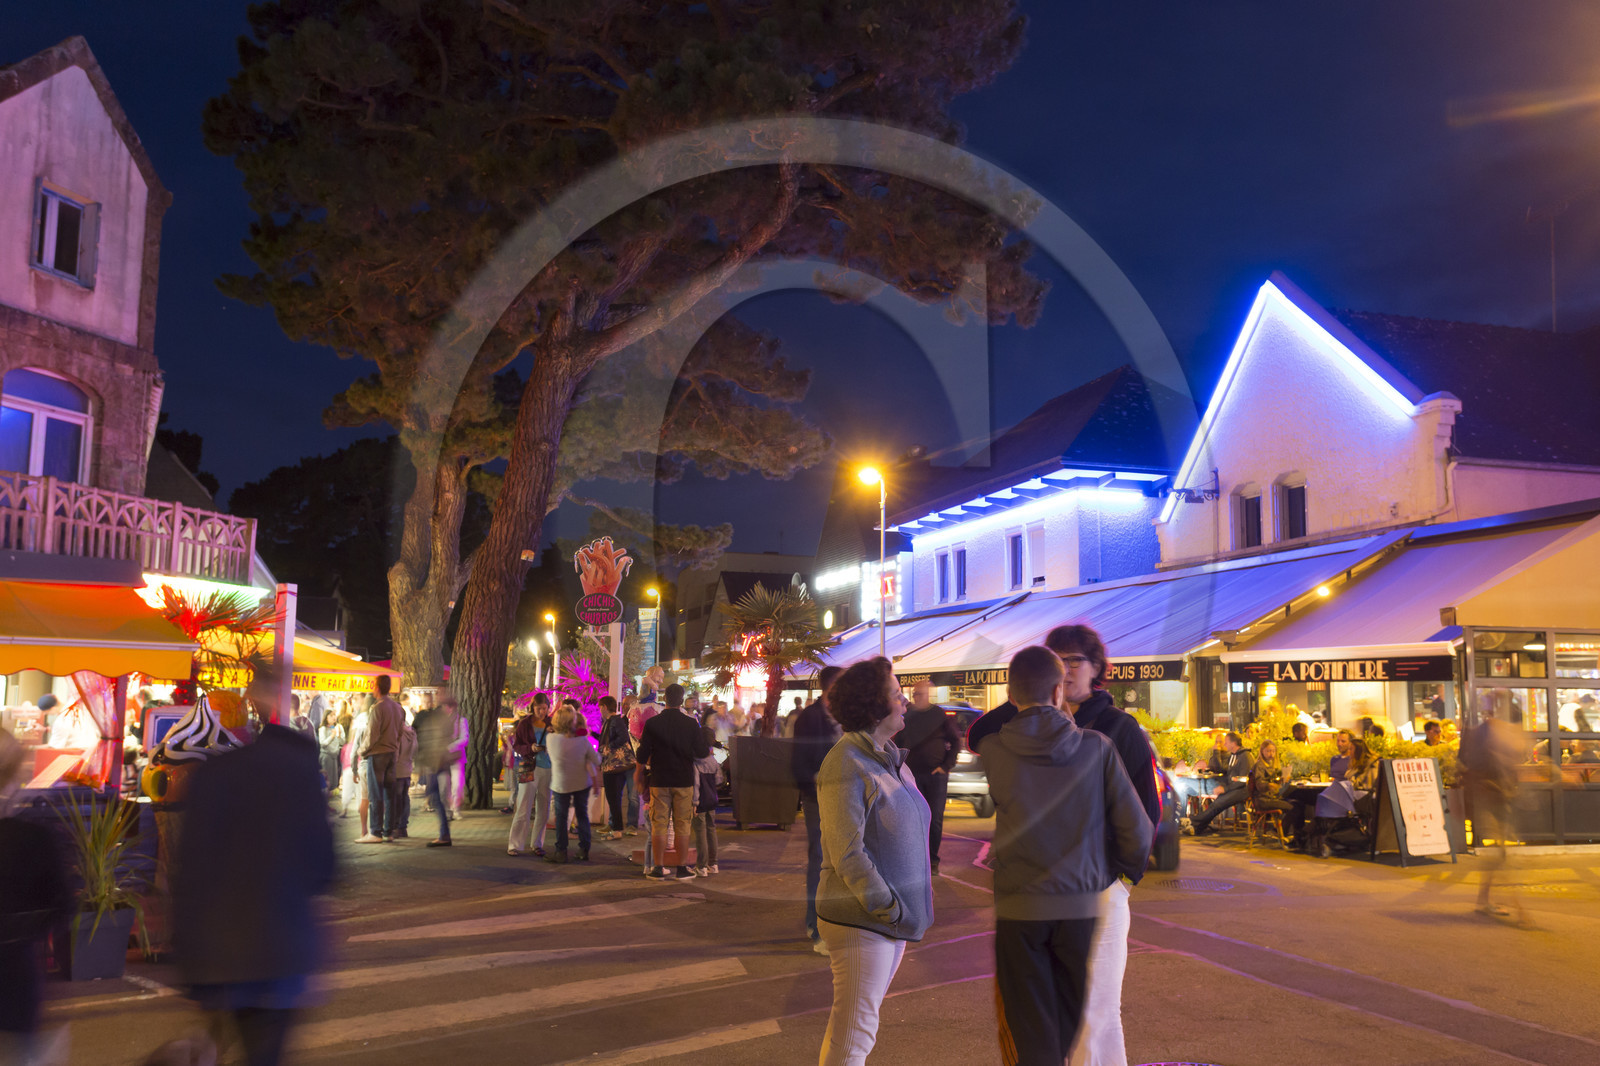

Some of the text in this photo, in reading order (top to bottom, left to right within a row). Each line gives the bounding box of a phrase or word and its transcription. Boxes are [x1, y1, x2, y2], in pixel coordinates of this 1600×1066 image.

[583, 594, 615, 608] CHICHIS
[580, 611, 618, 625] CHURROS
[965, 671, 976, 684] LA
[1106, 665, 1135, 680] EPUIS
[1139, 664, 1164, 679] 1930
[1273, 659, 1389, 681] LA POTINIERE
[350, 678, 376, 690] MAISO
[1396, 760, 1429, 772] CINEMA
